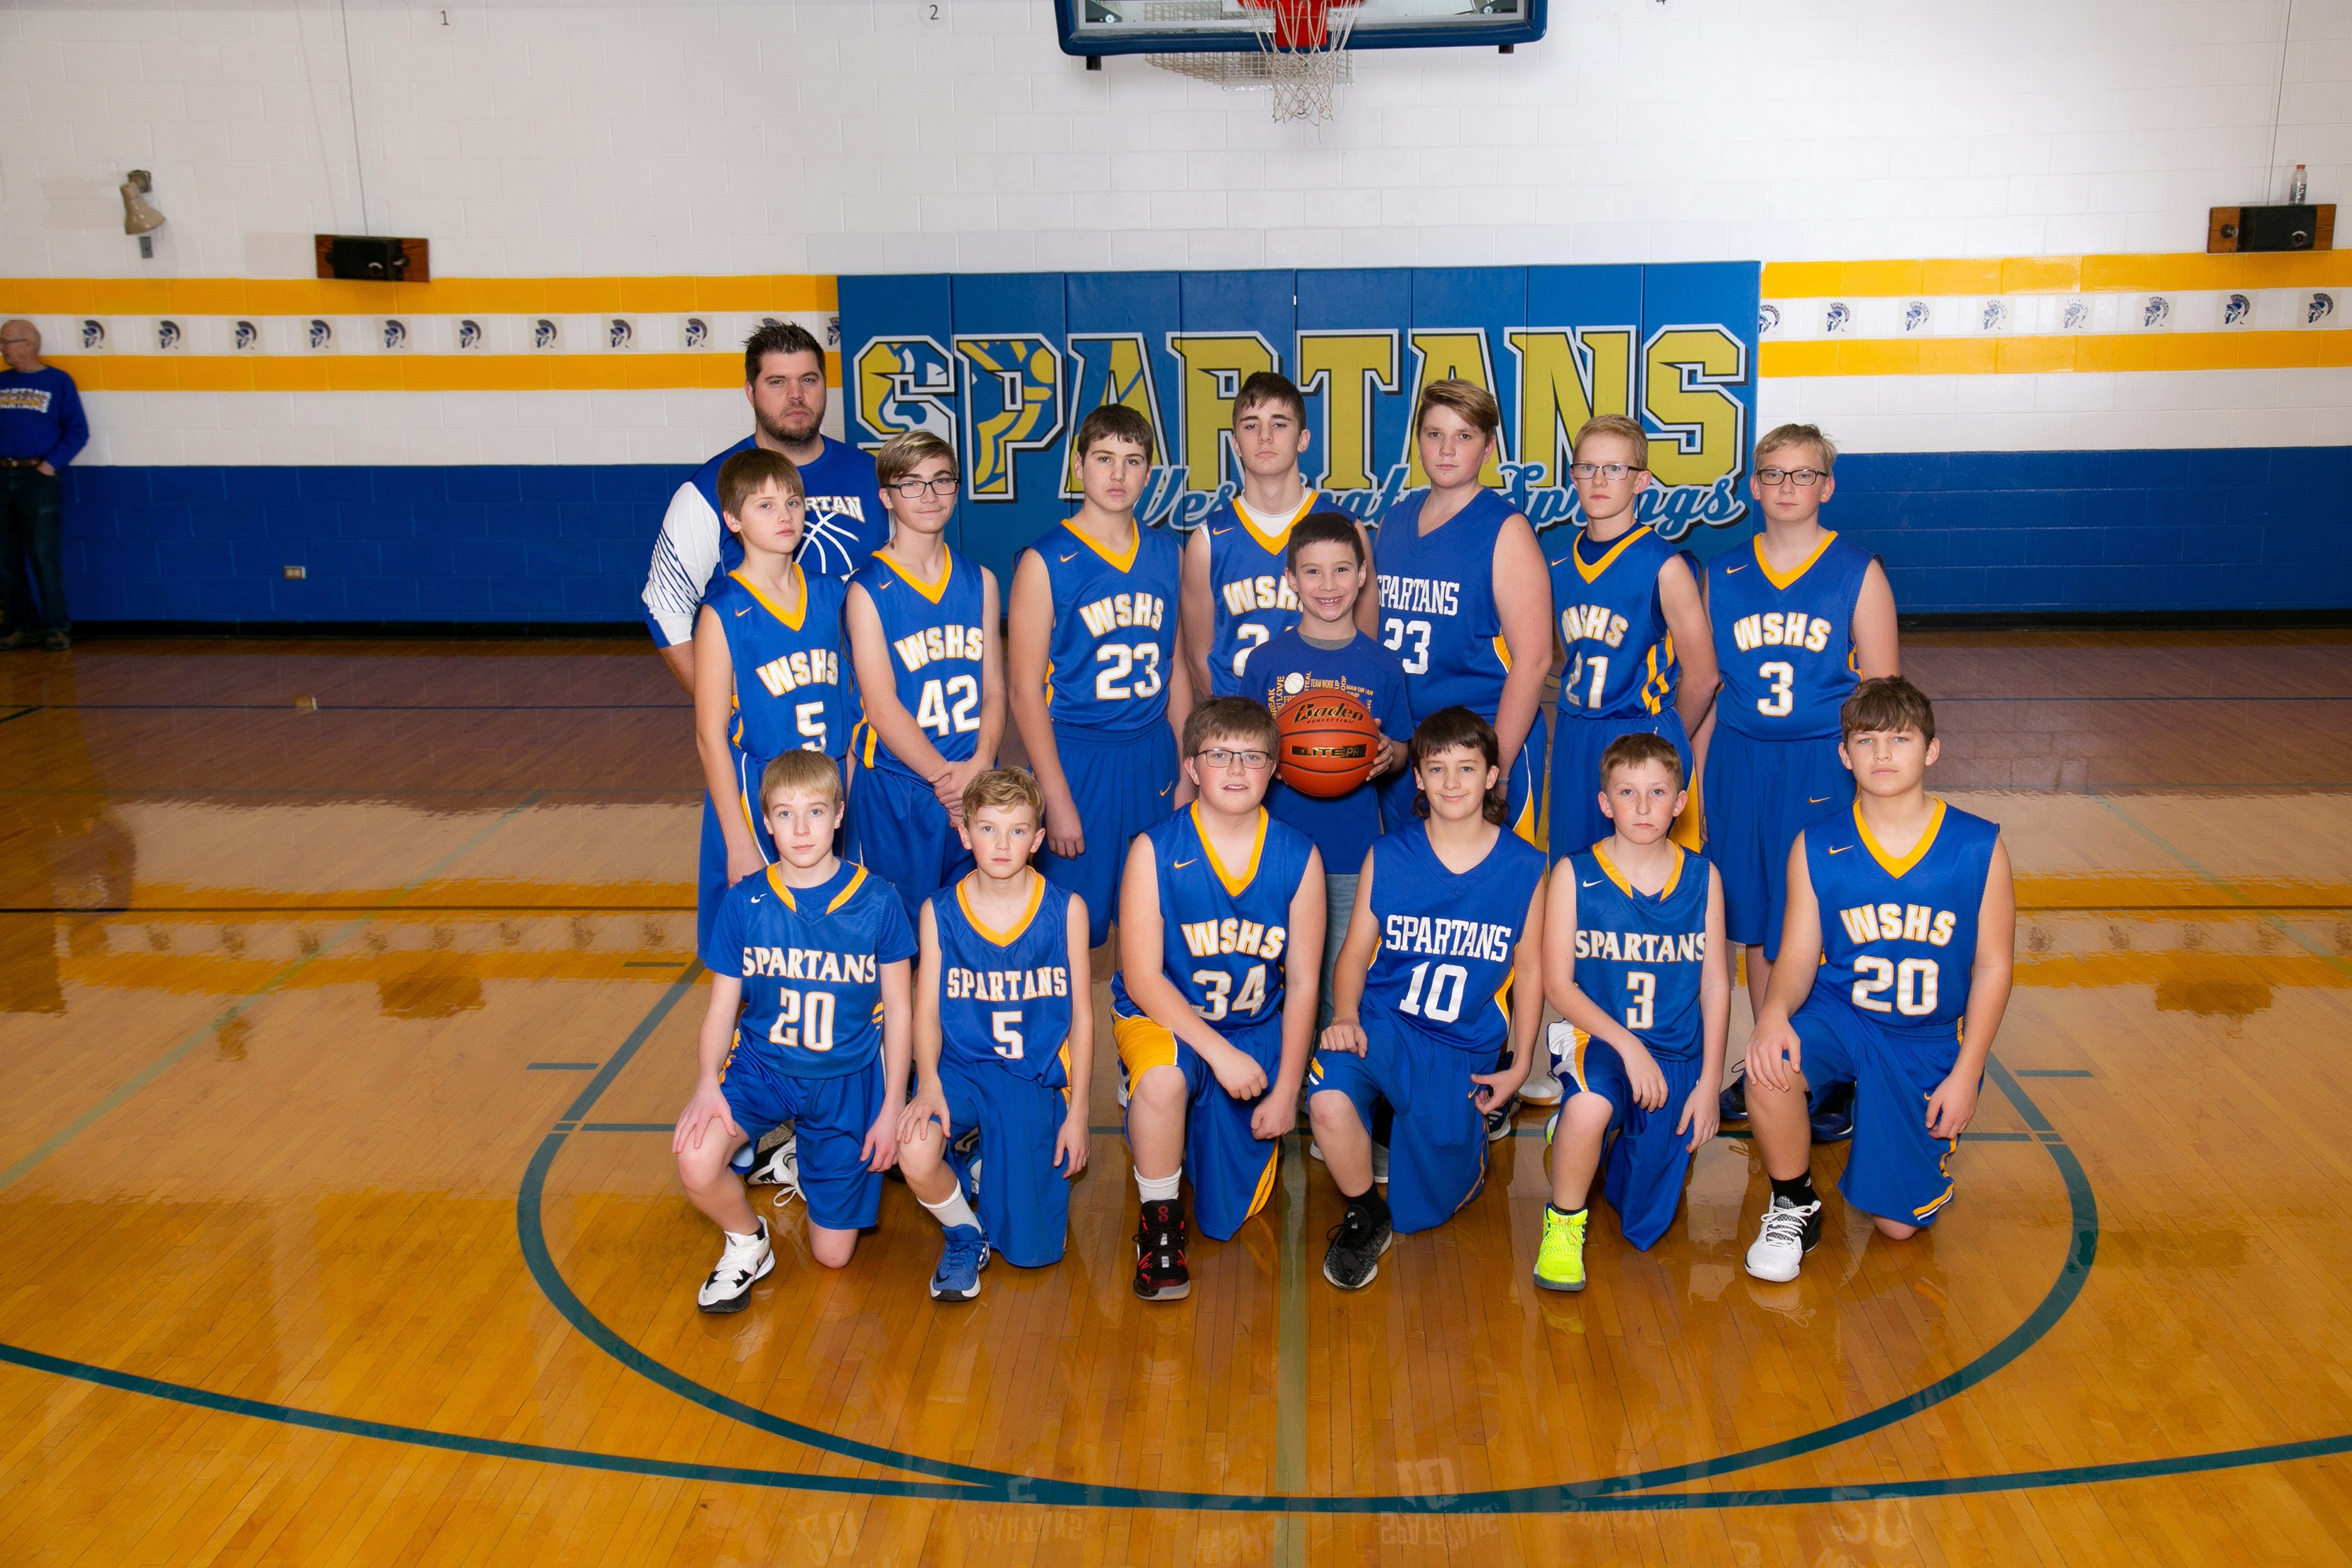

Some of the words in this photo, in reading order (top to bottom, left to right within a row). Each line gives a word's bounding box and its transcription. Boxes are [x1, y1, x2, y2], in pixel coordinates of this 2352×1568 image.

[439, 9, 451, 26] 1
[929, 4, 940, 20] 2
[853, 324, 1746, 500] SPARTANS
[804, 495, 866, 524] RTAN
[1496, 461, 1746, 541] Spngs
[1079, 592, 1164, 638] WSHS
[1222, 575, 1303, 616] WSH
[894, 624, 983, 673] WSHS
[1733, 612, 1832, 653] WSHS
[756, 648, 839, 698] WSHS
[1096, 642, 1162, 700] 23
[1276, 676, 1285, 702] LOVE
[1757, 662, 1794, 717] 3
[796, 701, 827, 753] 5
[916, 674, 981, 736] 42
[1293, 702, 1364, 724] Baden
[1181, 918, 1287, 960] WSHS
[1385, 913, 1513, 963] SPARTANS
[1574, 930, 1707, 964] SPARTANS
[1839, 902, 1957, 947] WSHS
[742, 946, 877, 984] SPARTANS
[947, 966, 1068, 1003] SPARTANS
[1852, 955, 1940, 1017] 20
[1190, 964, 1267, 1022] 34
[1399, 960, 1469, 1023] 10
[1626, 971, 1657, 1030] 3
[768, 987, 837, 1052] 20
[991, 1010, 1024, 1060] 5
